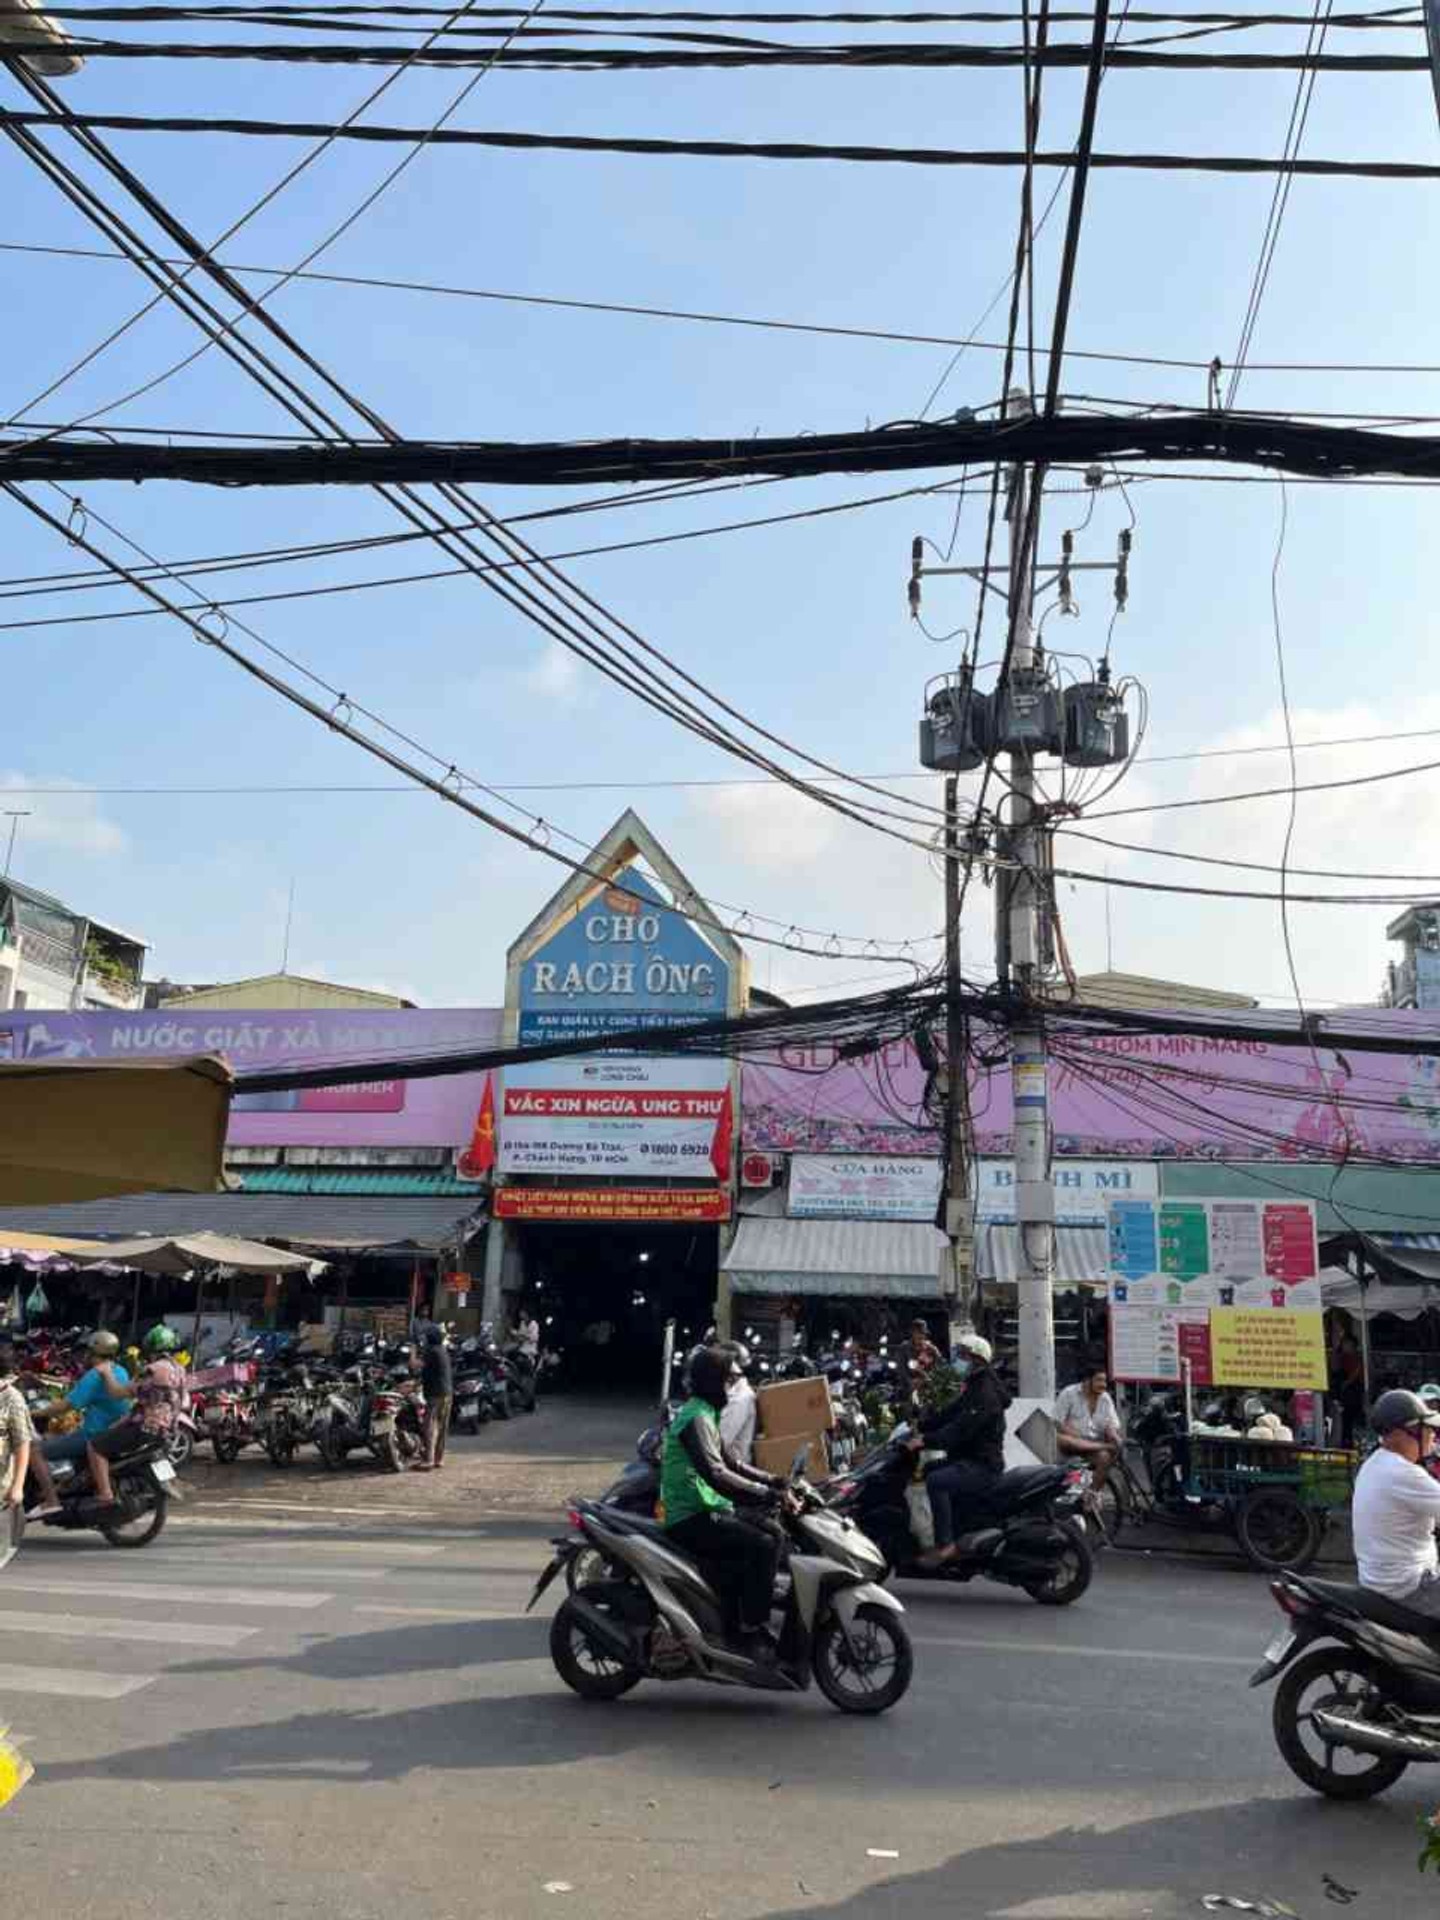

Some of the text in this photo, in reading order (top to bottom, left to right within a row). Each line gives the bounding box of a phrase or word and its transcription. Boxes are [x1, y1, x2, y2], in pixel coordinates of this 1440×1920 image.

[585, 913, 661, 949] CHỢ
[532, 956, 714, 1000] RẠCH ÔNG
[111, 1021, 195, 1049] NƯỚC
[203, 1023, 272, 1056] GIẶT
[283, 1021, 321, 1049] XẢ
[508, 1092, 724, 1114] VẮC XIN NGỪA UNG THƯ
[994, 1167, 1132, 1189] BH MÌ
